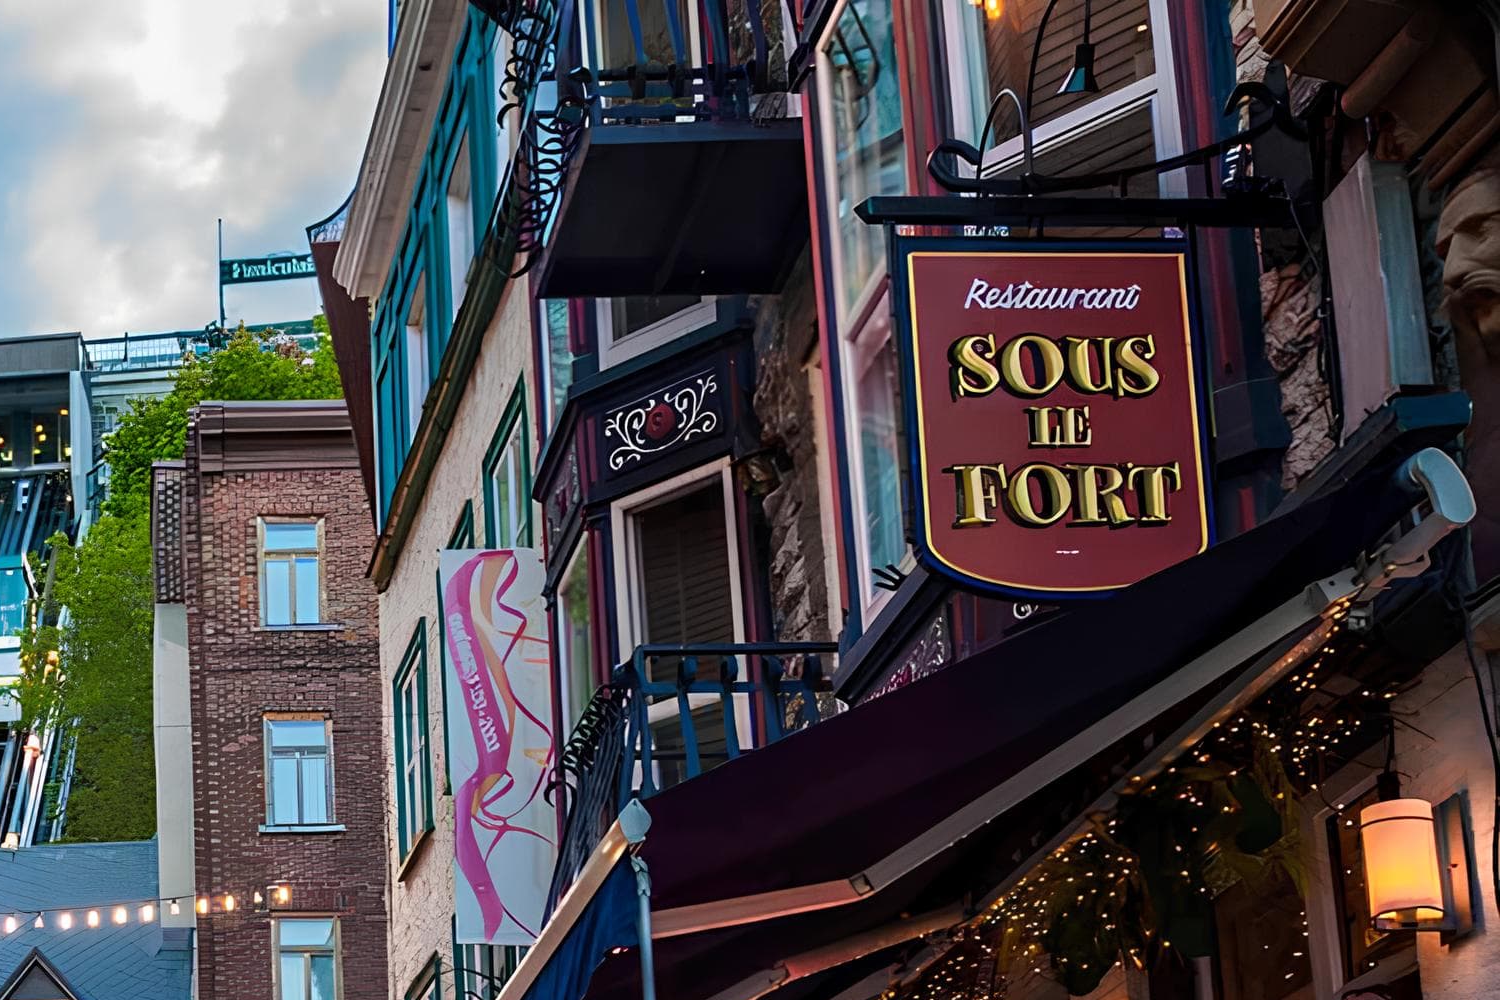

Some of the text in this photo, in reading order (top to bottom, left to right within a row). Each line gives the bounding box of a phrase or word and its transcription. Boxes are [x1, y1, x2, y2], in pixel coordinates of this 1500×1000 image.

[964, 278, 1141, 310] Restaurant
[950, 333, 1160, 398] SOUS
[1024, 405, 1092, 448] LE
[947, 461, 1181, 528] FORT
